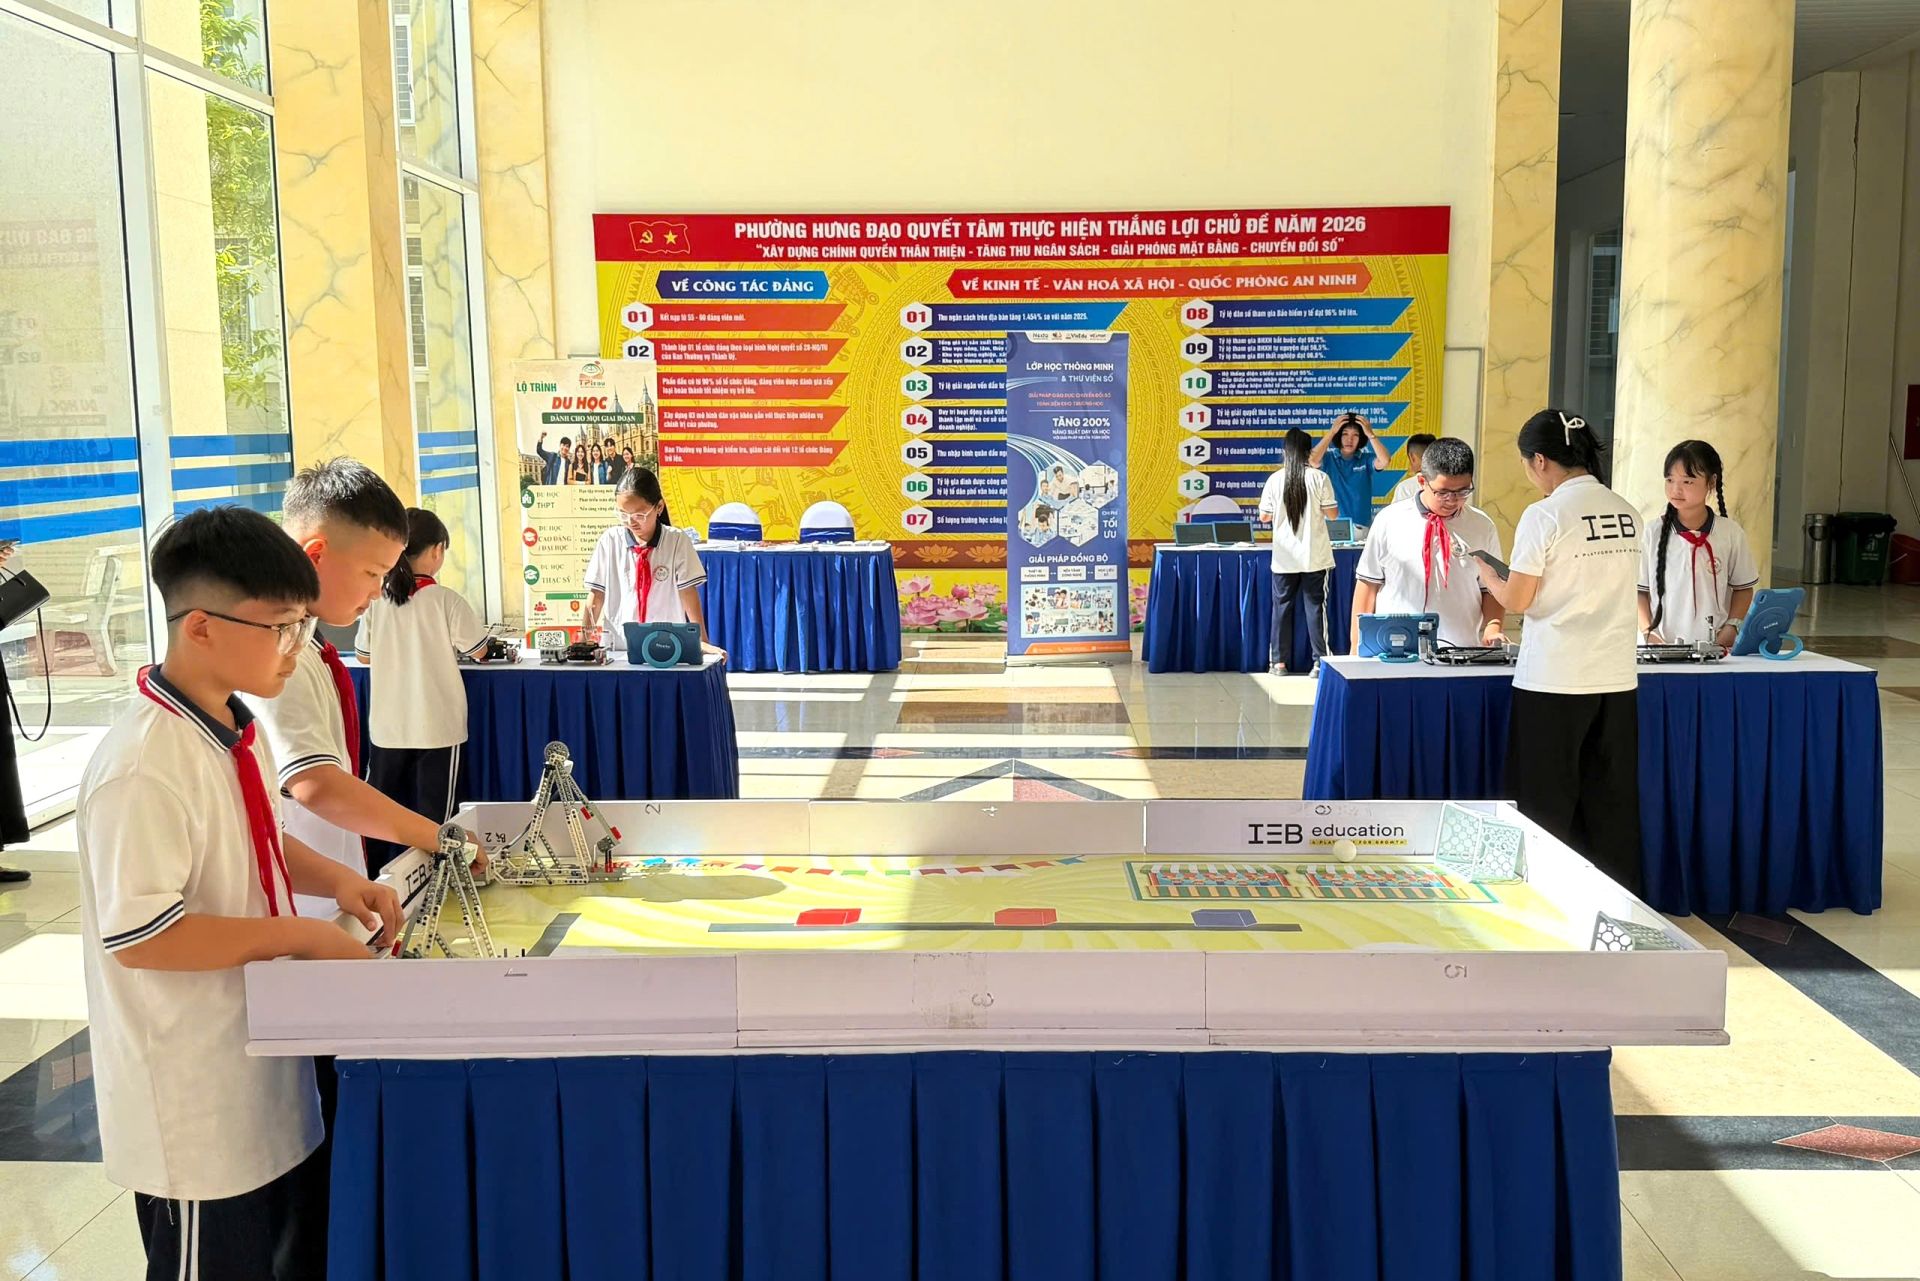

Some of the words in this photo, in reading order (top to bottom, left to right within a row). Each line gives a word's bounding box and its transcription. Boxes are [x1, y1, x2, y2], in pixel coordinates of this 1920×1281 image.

[734, 218, 807, 240] PHƯỜNG
[812, 219, 861, 239] HƯNG
[865, 219, 901, 242] ĐẠO
[907, 217, 961, 239] QUYẾT
[966, 216, 1004, 239] TÂM
[1010, 218, 1056, 241] THỰC
[1060, 218, 1102, 240] HIỆN
[1108, 215, 1167, 237] THẮNG
[1171, 217, 1199, 237] LỢI
[1204, 214, 1241, 236] CHỦ
[1245, 213, 1270, 235] ĐỀ
[1274, 213, 1317, 235] NĂM
[1321, 215, 1367, 233] 2026
[755, 243, 784, 259] “XÂY
[787, 245, 819, 260] DỰNG
[821, 242, 857, 258] CHÍNH
[859, 241, 897, 259] QUYỀN
[899, 243, 930, 258] THÂN
[932, 242, 966, 260] THIỆN
[976, 242, 1007, 257] TĂNG
[1009, 243, 1032, 257] THU
[1034, 241, 1066, 257] NGÂN
[1068, 241, 1100, 256] SÁCH
[1110, 239, 1134, 256] GIẢI
[1137, 239, 1177, 255] PHÓNG
[1179, 239, 1204, 257] MẶT
[1207, 238, 1240, 254] BẰNG
[1250, 236, 1296, 253] CHUYỂN
[1298, 236, 1319, 253] ĐỔI
[1321, 237, 1345, 252] SỐ”
[671, 277, 689, 292] VỀ
[692, 277, 736, 293] CÔNG
[740, 278, 769, 293] TÁC
[772, 277, 814, 293] ĐẢNG
[961, 277, 979, 291] VỀ
[982, 279, 1020, 291] KINH
[1023, 277, 1042, 291] TẾ
[1052, 277, 1083, 291] VĂN
[1087, 277, 1120, 290] HOÁ
[1123, 276, 1145, 290] XÃ
[1147, 276, 1175, 292] HỘI
[1187, 275, 1232, 290] QUỐC
[1235, 274, 1289, 287] PHÒNG
[1292, 276, 1315, 286] AN
[1318, 274, 1357, 286] NINH
[627, 310, 648, 323] 01
[906, 311, 927, 323] 01
[1186, 308, 1209, 320] 08
[627, 345, 650, 357] 02
[905, 345, 928, 358] 02
[1185, 342, 1208, 355] 09
[1026, 360, 1044, 371] LỚP
[1044, 362, 1062, 373] HỌC
[1063, 360, 1093, 371] THÔNG
[1093, 362, 1114, 371] MINH
[1061, 375, 1067, 383] &
[1068, 375, 1085, 383] THƯ
[1085, 374, 1103, 384] VIỆN
[1103, 373, 1114, 383] SỐ
[1185, 377, 1207, 389] 10
[516, 380, 528, 394] LỘ
[531, 380, 557, 392] TRÌNH
[905, 380, 928, 392] 03
[551, 396, 573, 410] DU
[576, 396, 608, 412] HỌC
[550, 413, 570, 422] DÀNH
[586, 415, 600, 423] MỌI
[617, 415, 636, 423] ĐOẠN
[906, 413, 928, 426] 04
[1052, 415, 1081, 427] TĂNG
[1082, 417, 1111, 427] 200%
[1186, 411, 1206, 423] 11
[906, 447, 928, 459] 05
[1184, 445, 1206, 457] 12
[906, 480, 928, 493] 06
[1183, 479, 1205, 491] 13
[906, 513, 928, 525] 07
[1103, 516, 1118, 528] TỐI
[1581, 514, 1636, 542] IEB
[1103, 530, 1117, 539] ƯU
[1028, 553, 1046, 564] GIẢI
[1047, 553, 1069, 563] PHÁP
[1070, 552, 1095, 563] ĐỒNG
[1096, 552, 1109, 564] BỘ
[644, 802, 661, 815] 2
[1248, 823, 1304, 845] IEB
[1311, 823, 1404, 838] education
[1444, 963, 1467, 979] 5
